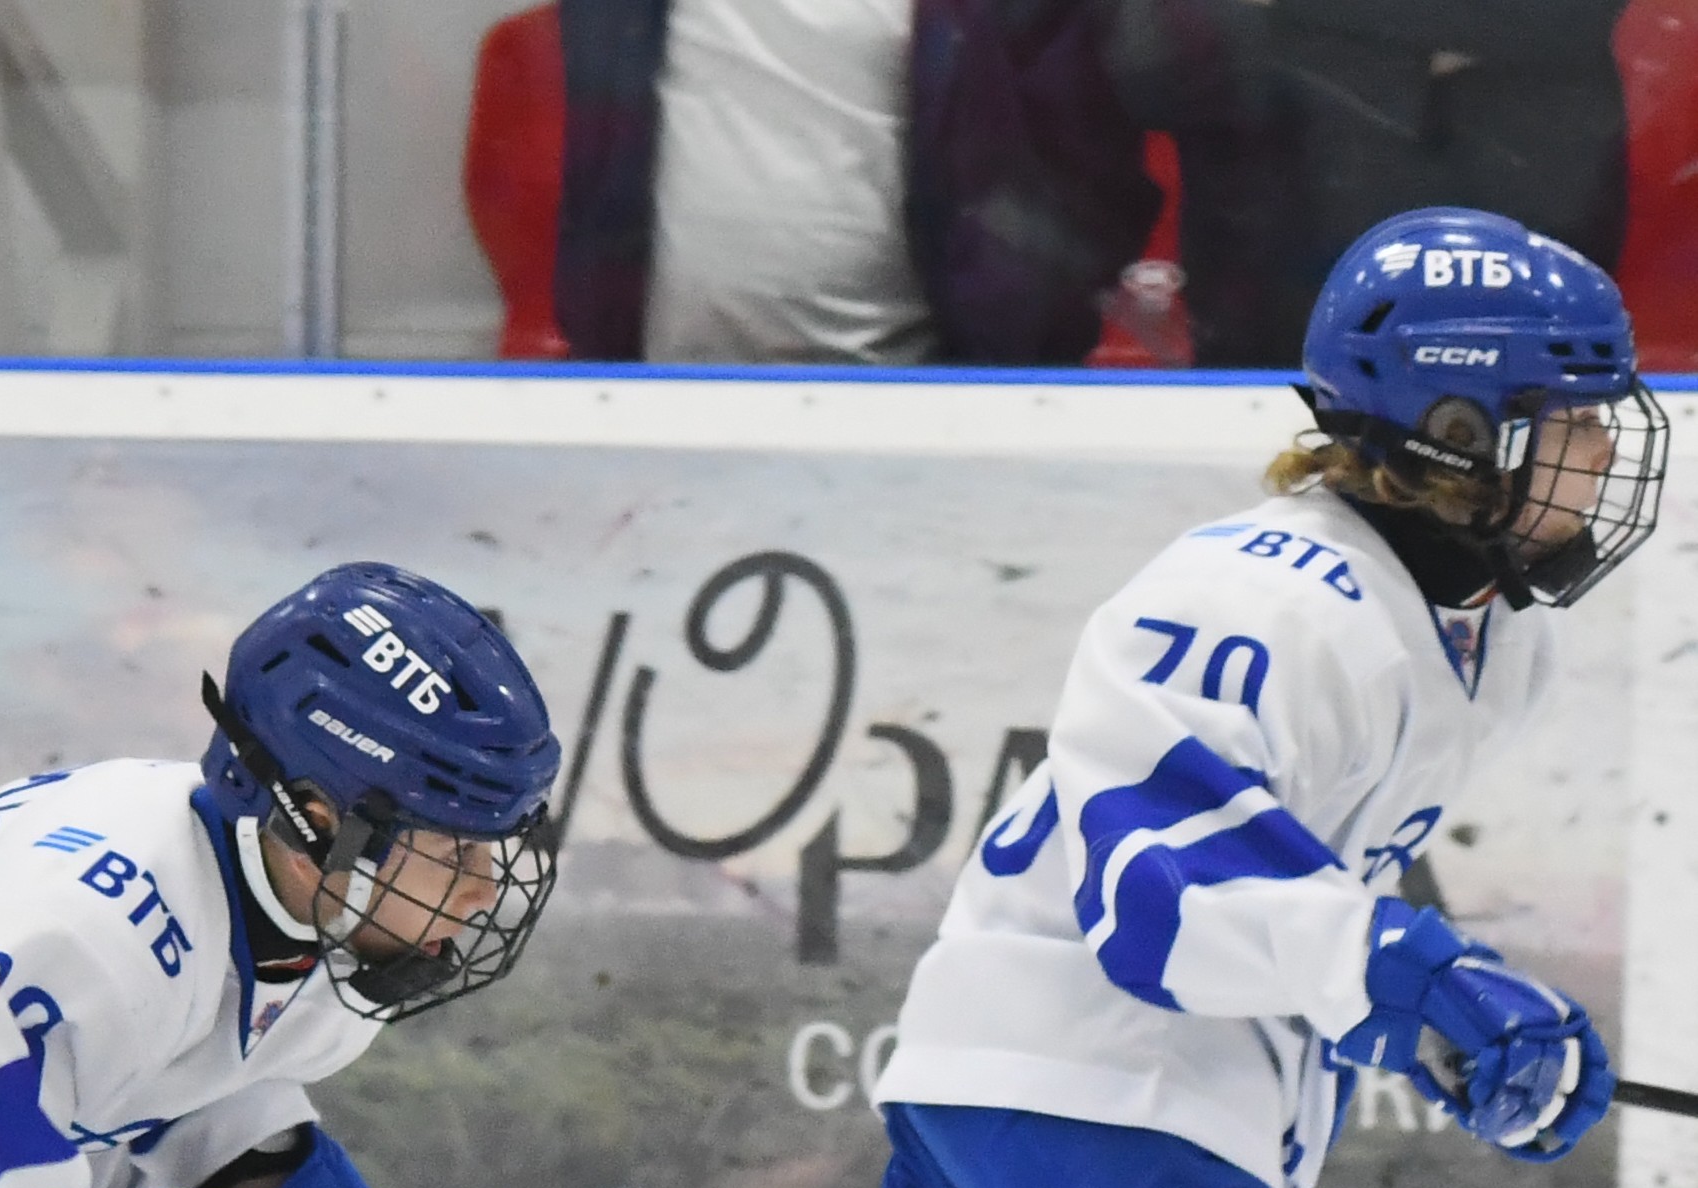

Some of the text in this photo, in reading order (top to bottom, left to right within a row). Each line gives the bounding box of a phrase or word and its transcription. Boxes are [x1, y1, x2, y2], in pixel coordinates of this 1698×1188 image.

[1423, 249, 1513, 288] ВТБ
[1414, 346, 1500, 367] CCM
[361, 630, 452, 715] ВТБ
[1133, 616, 1270, 721] 70
[308, 708, 396, 764] BAUER
[77, 849, 194, 978] ВТБ
